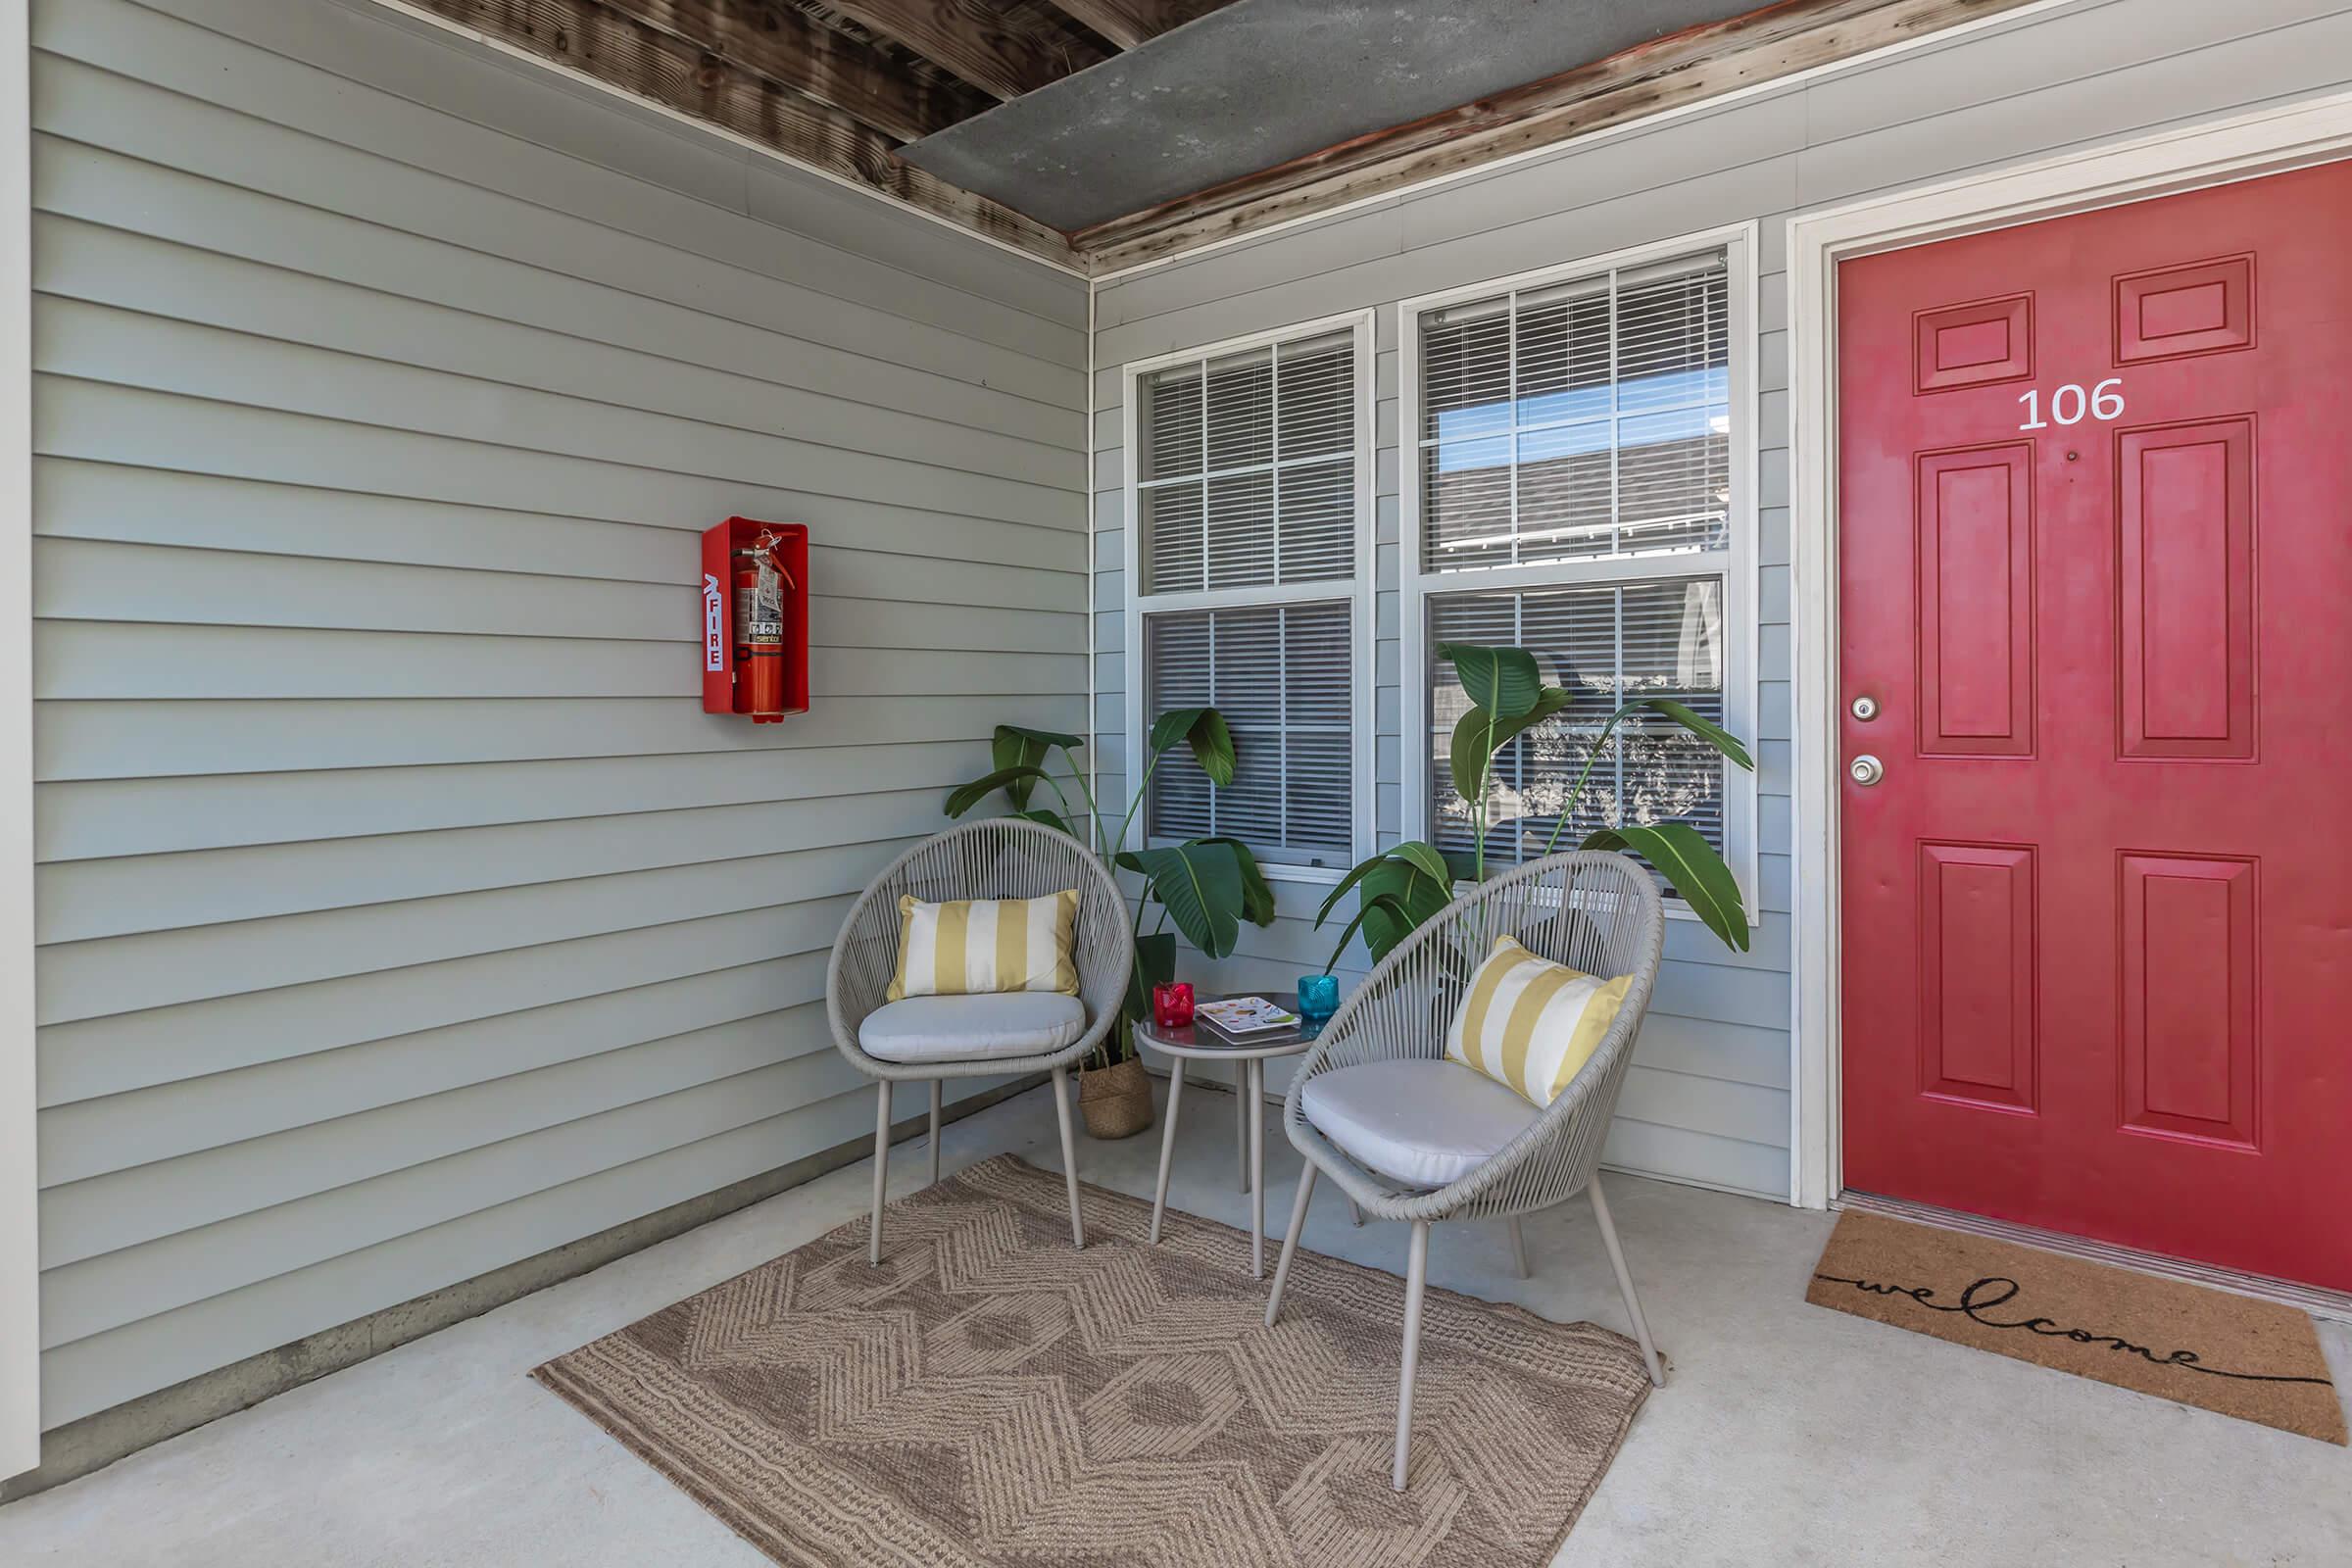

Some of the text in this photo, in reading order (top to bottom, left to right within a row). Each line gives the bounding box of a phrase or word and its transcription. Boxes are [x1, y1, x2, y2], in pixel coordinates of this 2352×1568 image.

[2018, 377, 2125, 430] 106
[710, 598, 720, 664] FIRE
[1815, 1275, 2334, 1387] welcome
